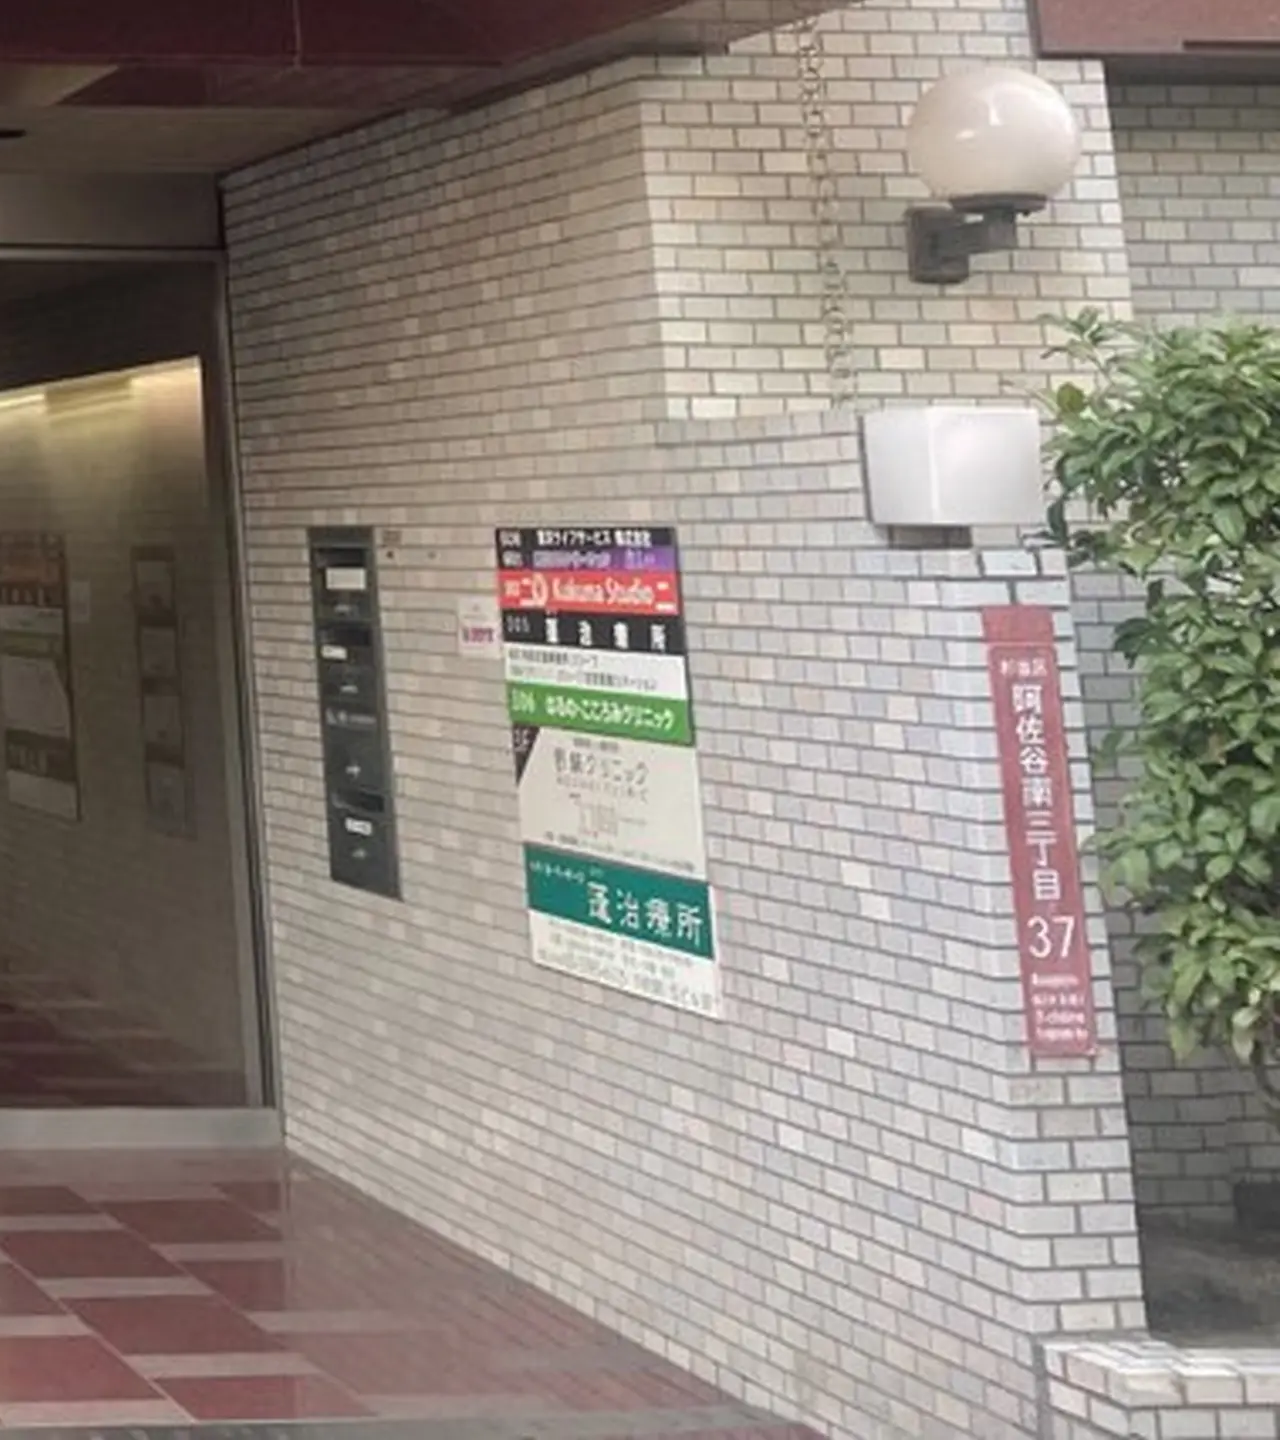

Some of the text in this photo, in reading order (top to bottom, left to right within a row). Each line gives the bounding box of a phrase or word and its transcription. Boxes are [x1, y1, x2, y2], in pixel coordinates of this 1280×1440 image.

[1012, 684, 1061, 900] 阿佐谷南三丁目
[1027, 915, 1076, 958] 37
